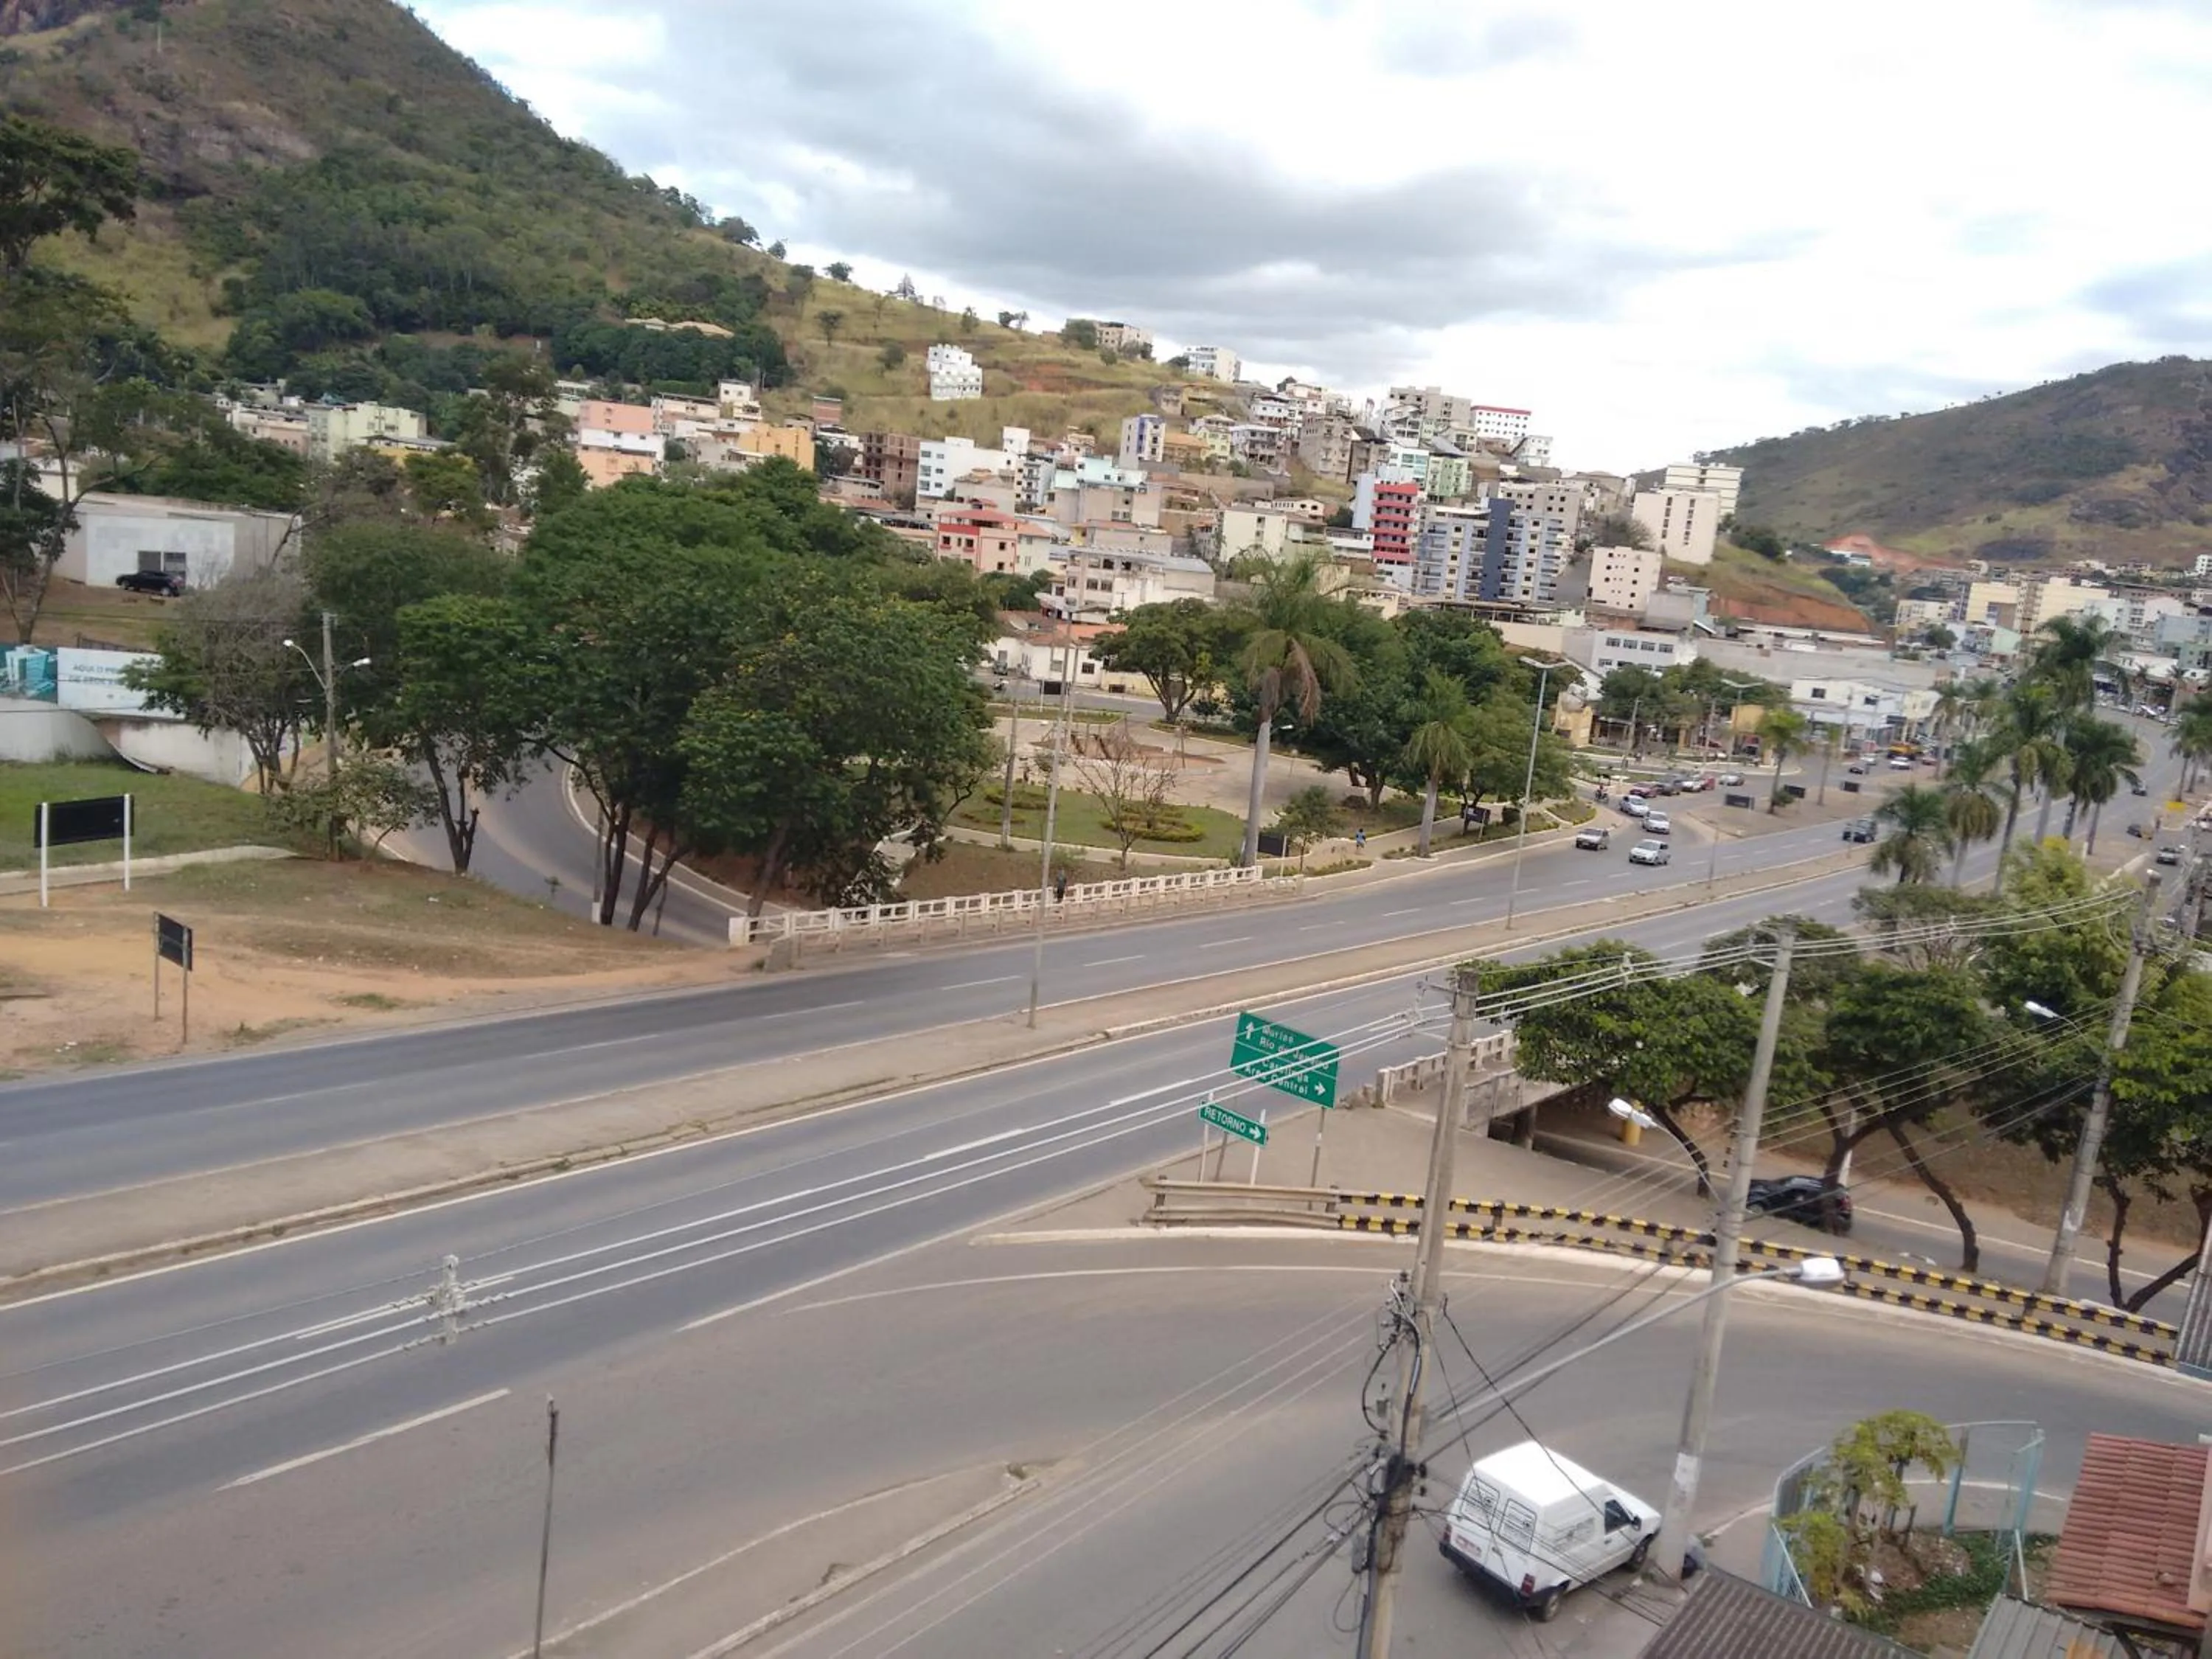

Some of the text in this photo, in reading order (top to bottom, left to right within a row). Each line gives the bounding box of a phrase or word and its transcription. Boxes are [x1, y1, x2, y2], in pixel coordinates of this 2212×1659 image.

[1259, 1036, 1275, 1049] Rio
[1262, 1058, 1309, 1083] Caratiga
[1204, 1107, 1247, 1133] RETORNO
